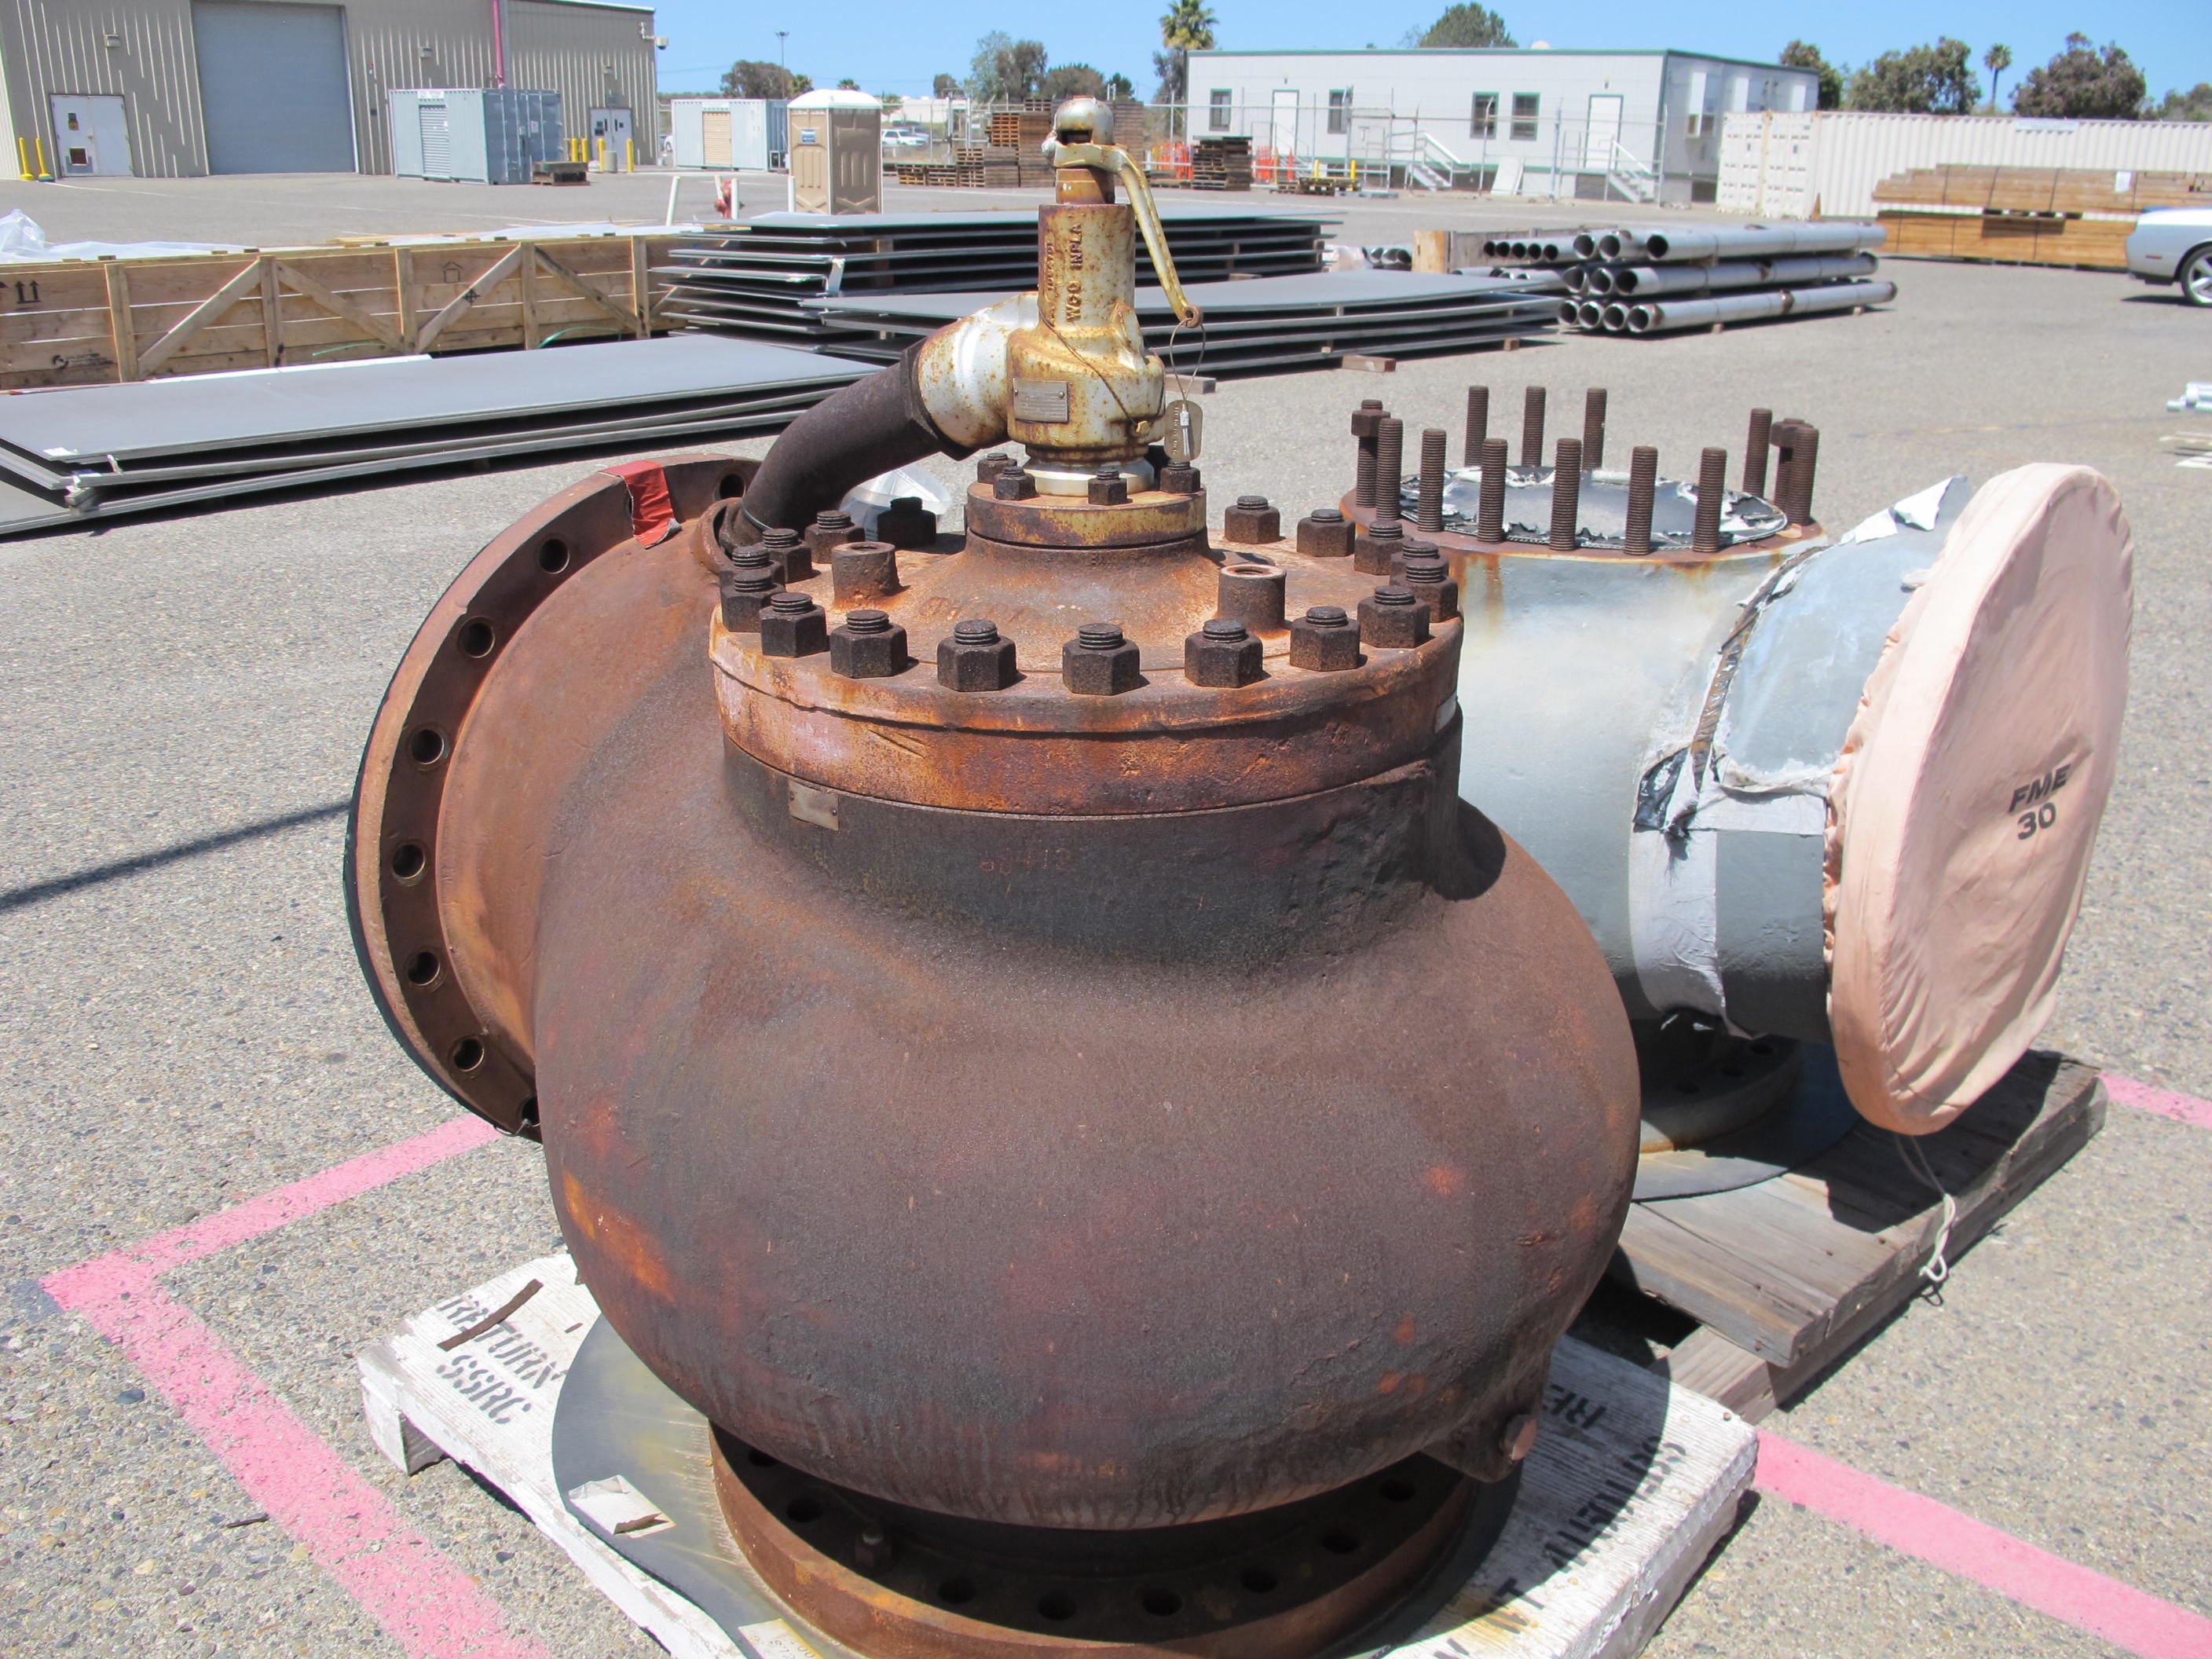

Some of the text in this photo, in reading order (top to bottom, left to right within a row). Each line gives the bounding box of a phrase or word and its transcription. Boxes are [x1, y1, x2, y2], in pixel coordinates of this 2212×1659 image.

[2009, 764, 2071, 813] FME
[2016, 802, 2056, 840] 30
[435, 1354, 533, 1425] SSRC
